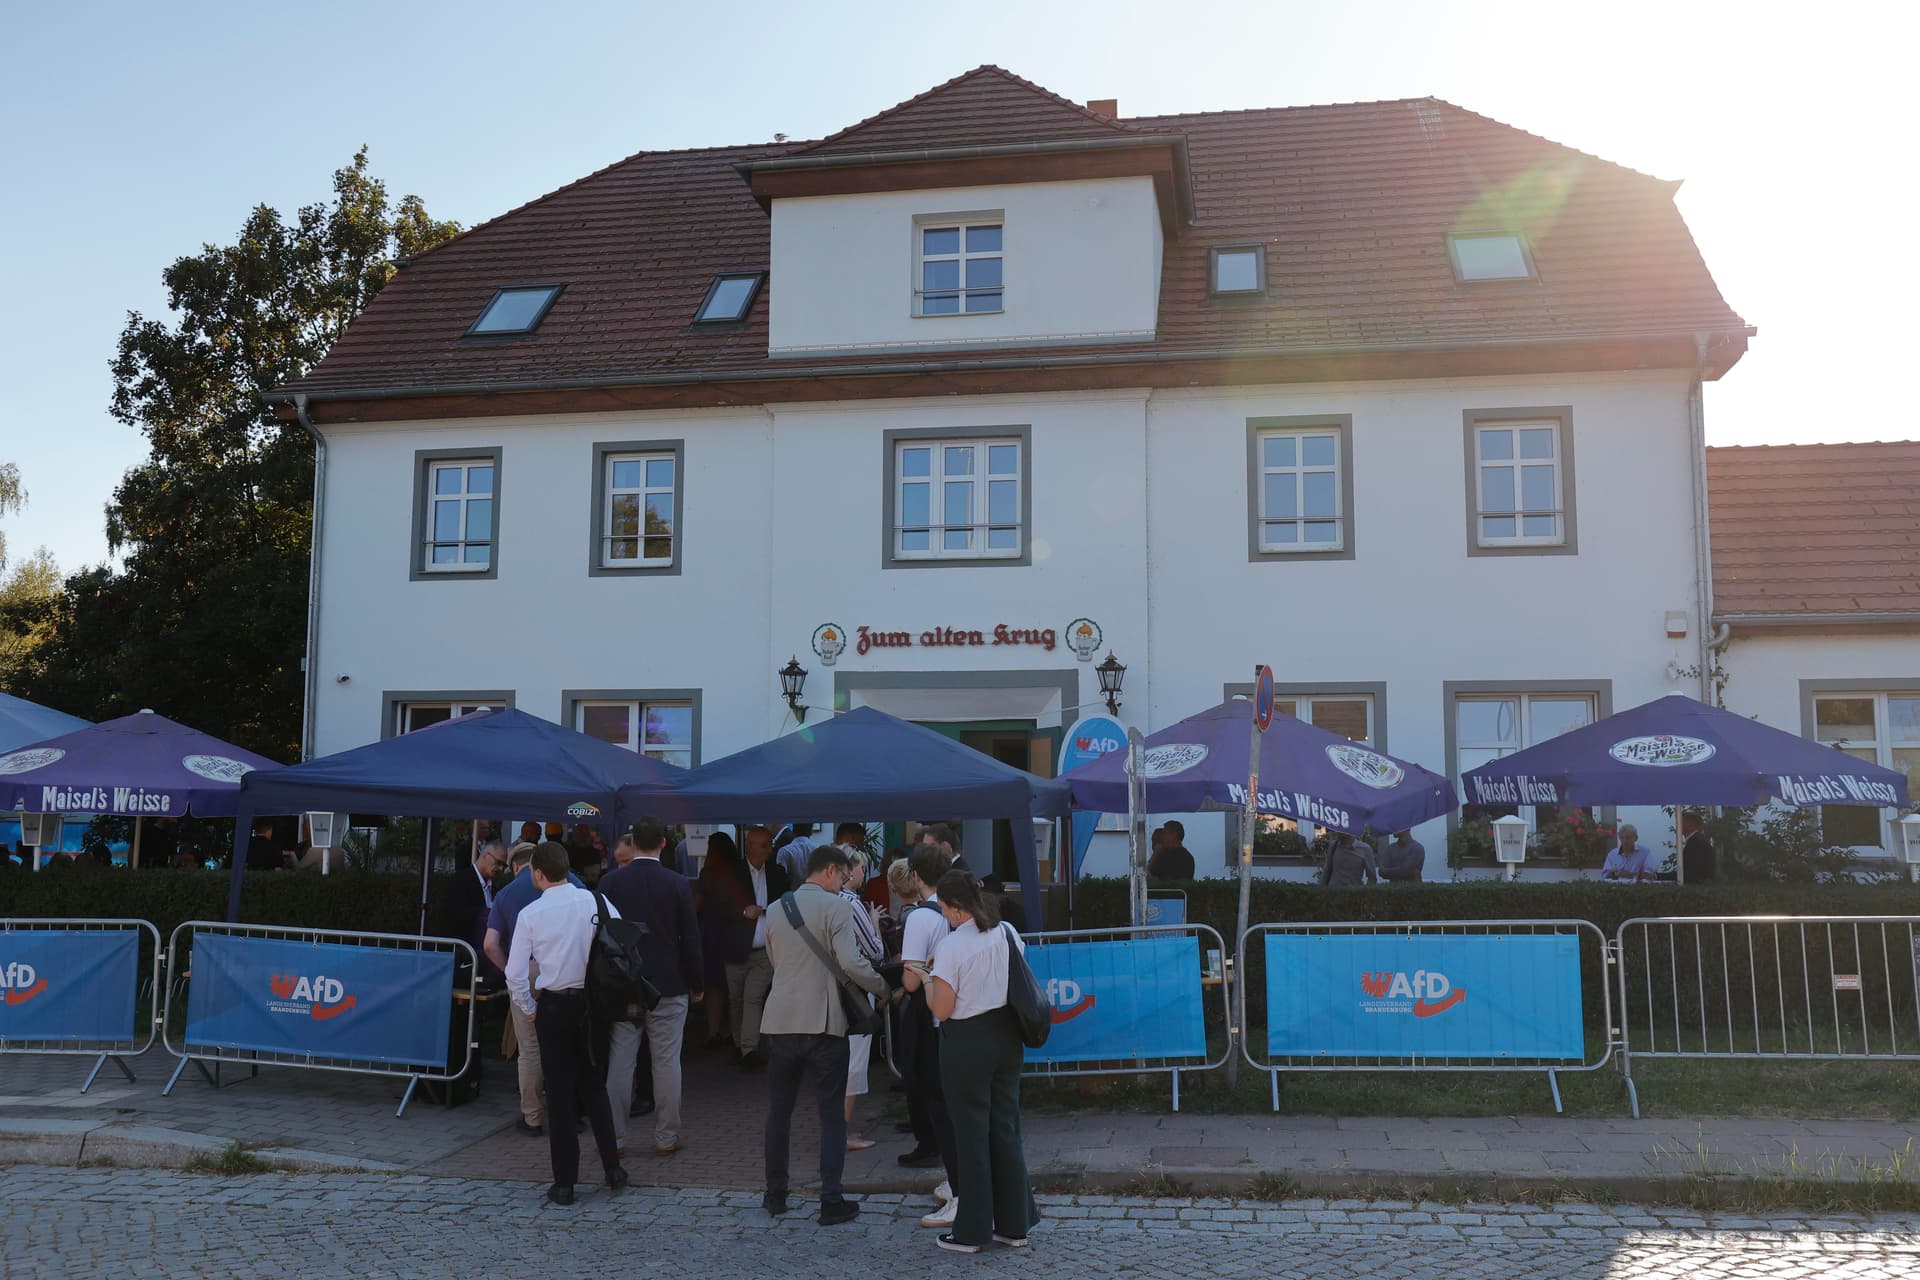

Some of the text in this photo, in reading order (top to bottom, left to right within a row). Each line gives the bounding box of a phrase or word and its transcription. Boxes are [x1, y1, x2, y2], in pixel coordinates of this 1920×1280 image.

[856, 623, 1056, 655] Zum alten Krug
[1088, 737, 1119, 752] AfD
[42, 786, 170, 813] Maisel's Weisse
[1473, 775, 1559, 804] Maisel's Weisse
[1778, 775, 1898, 806] Maisel's Weisse
[1227, 783, 1350, 829] Msel's Weisse
[291, 975, 344, 1003] AfD
[1045, 978, 1081, 1006] fD
[1388, 969, 1450, 998] AfD
